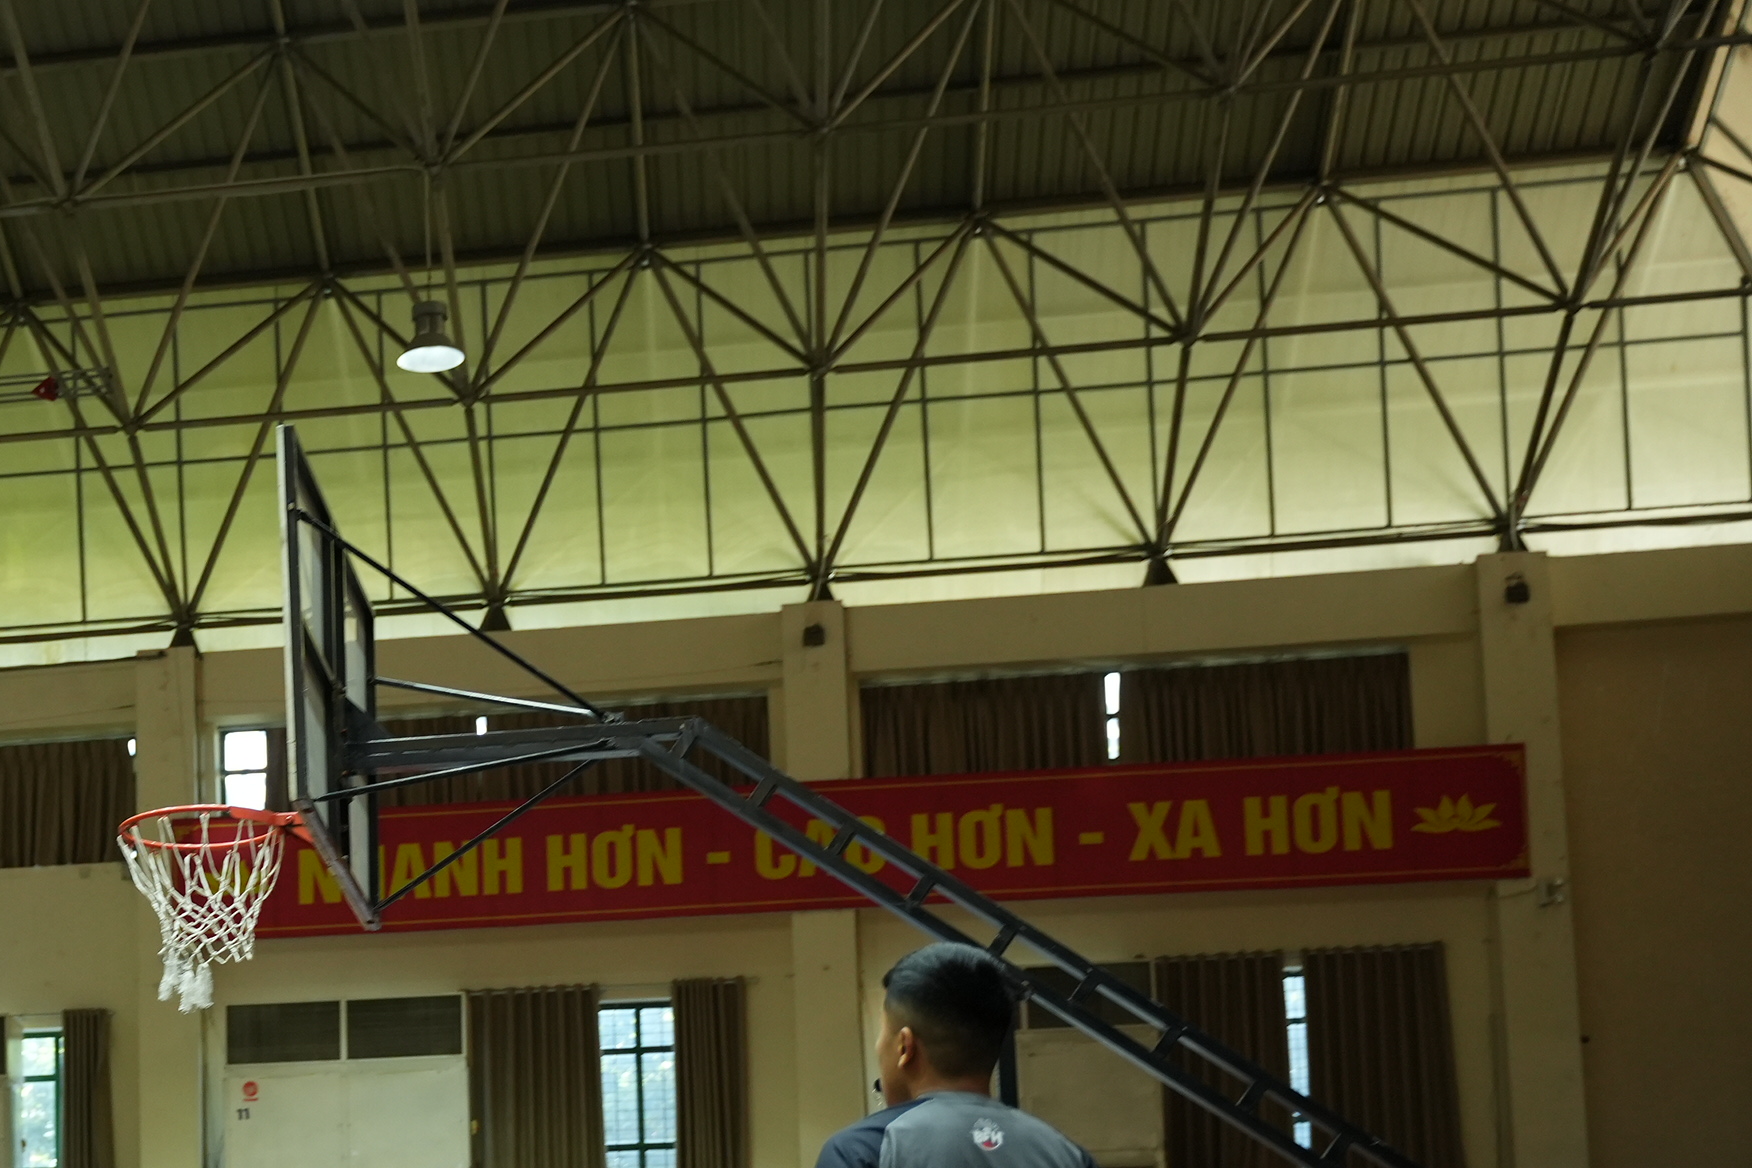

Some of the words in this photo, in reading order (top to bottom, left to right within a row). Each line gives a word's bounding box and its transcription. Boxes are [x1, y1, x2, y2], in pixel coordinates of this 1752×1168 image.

[298, 837, 524, 905] NANH
[546, 823, 683, 893] HƠN
[910, 802, 1055, 871] HƠN
[1128, 800, 1222, 862] XA
[1243, 786, 1395, 857] HƠN
